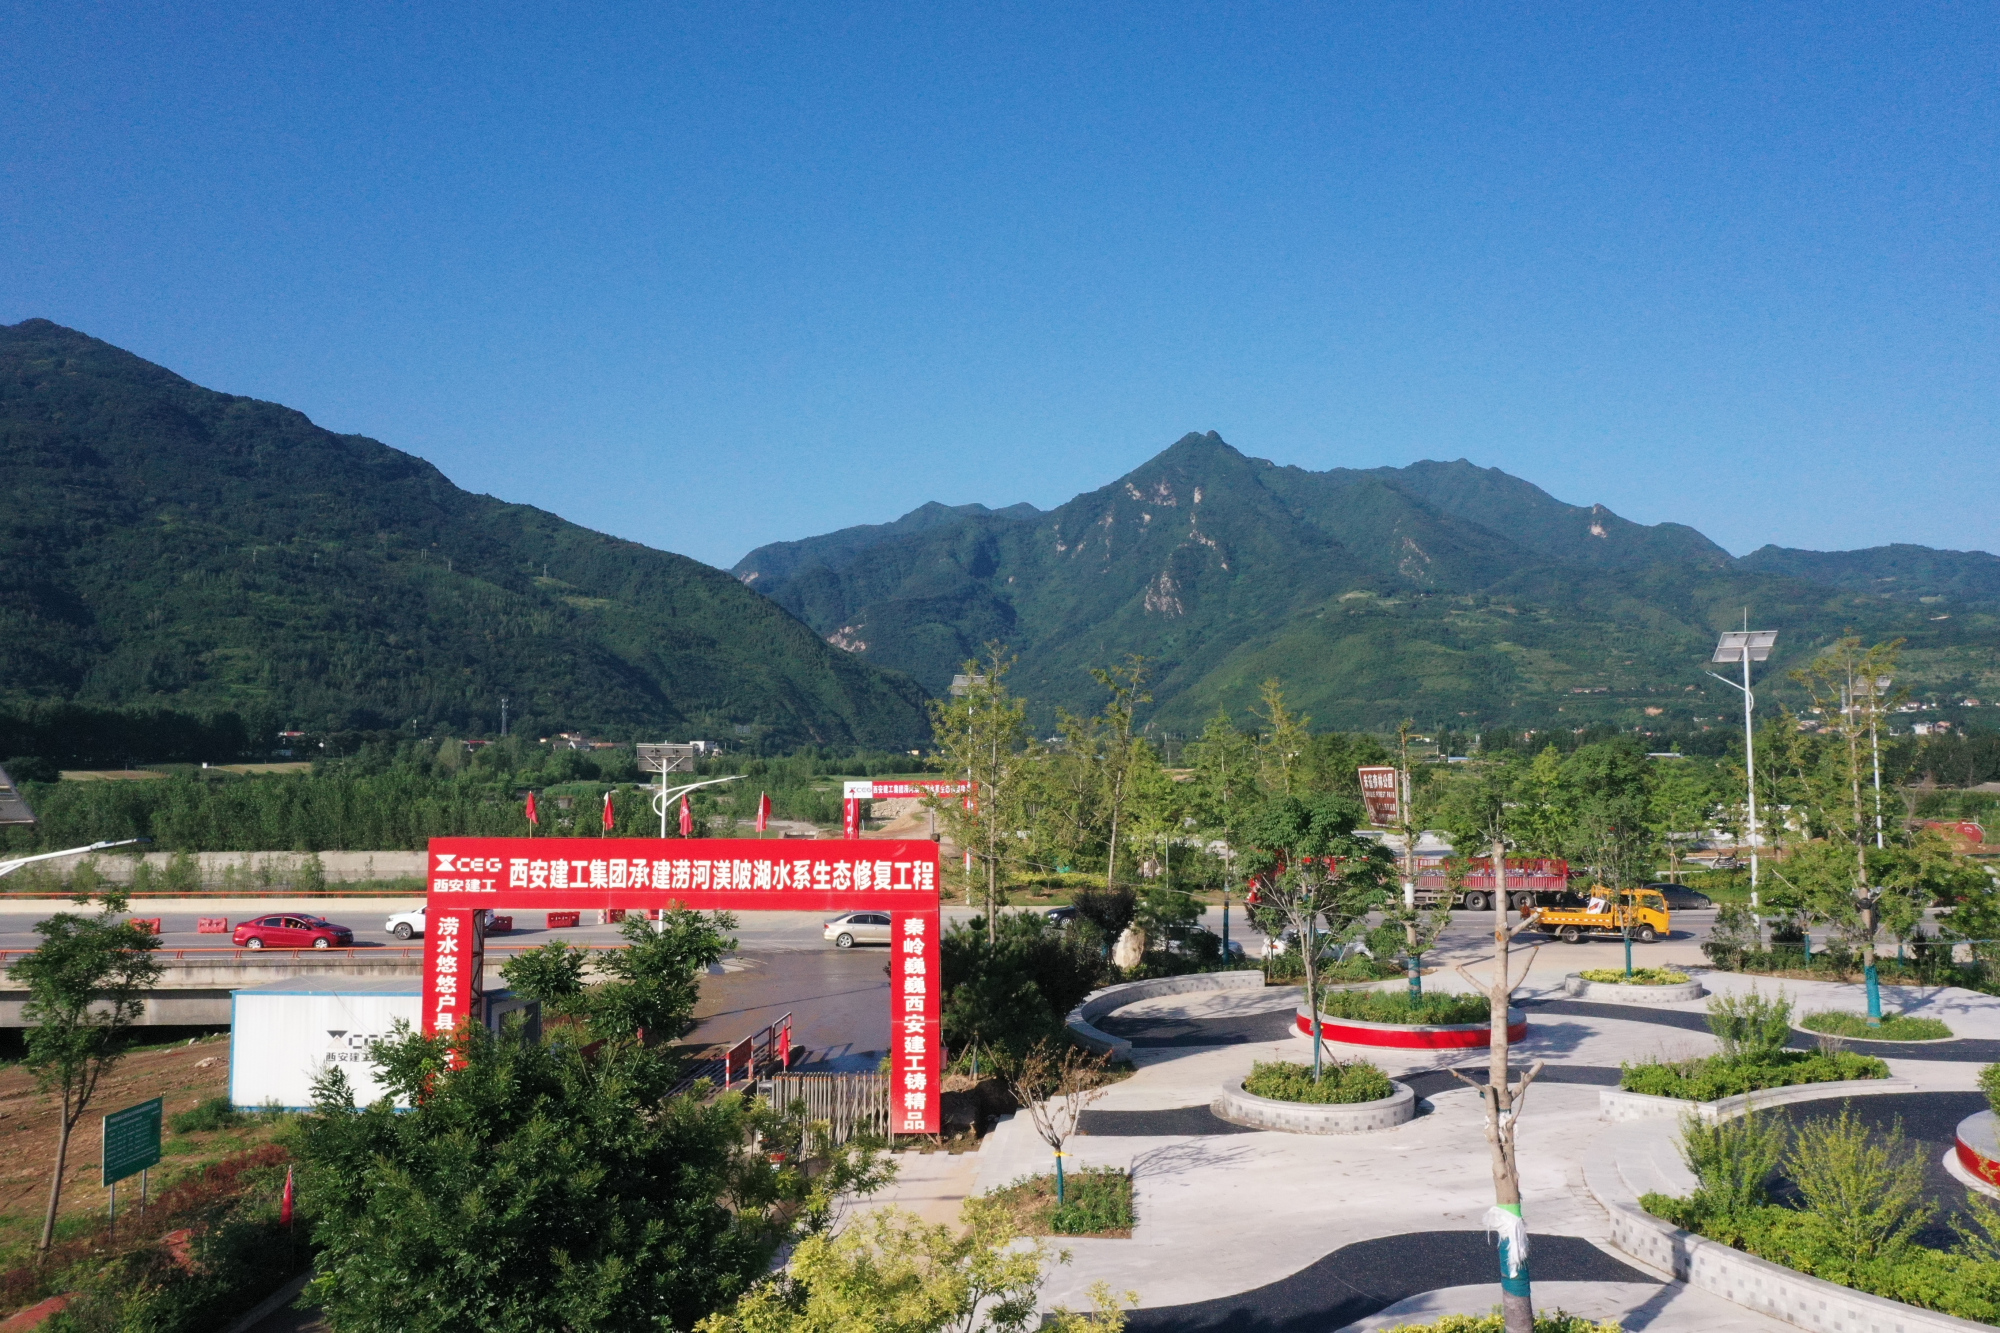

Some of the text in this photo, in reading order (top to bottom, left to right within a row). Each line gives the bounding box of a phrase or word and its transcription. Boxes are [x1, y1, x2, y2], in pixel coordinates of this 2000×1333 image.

[433, 878, 497, 893] 西安建工
[510, 858, 935, 891] 西安建工集团承建涝河渼陂湖水系生态修复工程
[433, 916, 460, 1069] 涝水悠悠户县
[903, 917, 926, 1130] 秦岭巍巍西安建工铸精品
[326, 1052, 373, 1063] 西安建工
